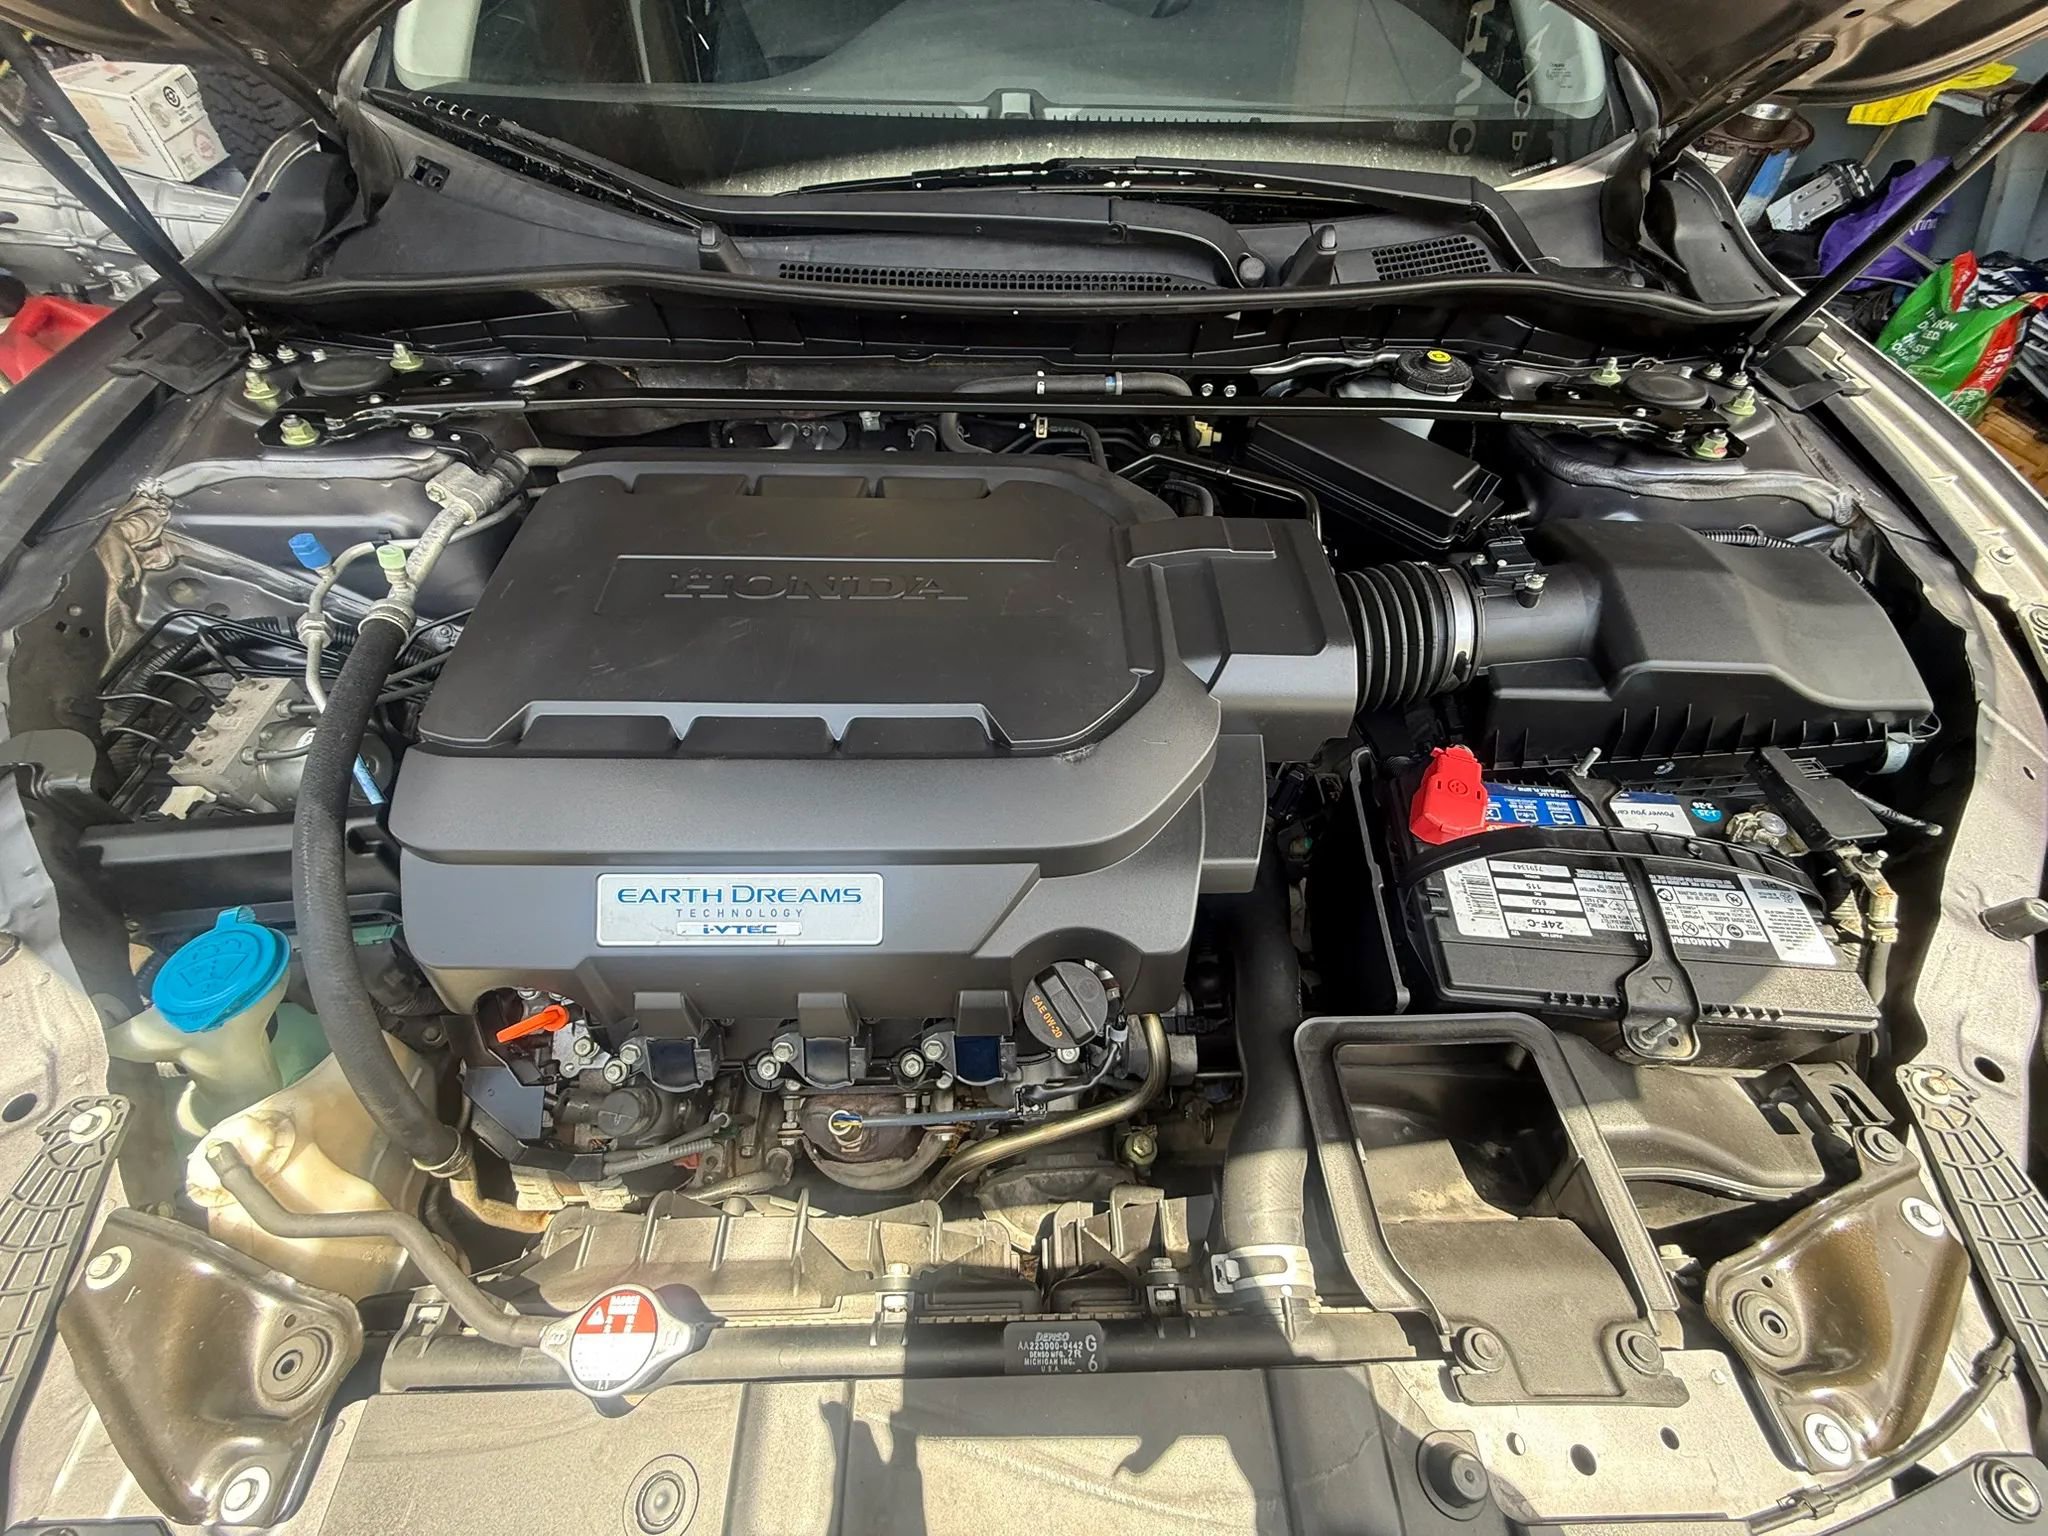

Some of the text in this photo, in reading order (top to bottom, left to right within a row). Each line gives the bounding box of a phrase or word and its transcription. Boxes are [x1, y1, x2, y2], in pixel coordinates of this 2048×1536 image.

[664, 573, 969, 600] HONDA
[617, 884, 863, 905] EARTH DREAMS
[676, 908, 804, 918] TECHNOLOGY
[702, 923, 778, 935] i-VTEC
[1527, 919, 1564, 930] 24F-C
[1031, 995, 1063, 1039] SAE 0W-20
[1035, 1331, 1070, 1342] DENSO
[1085, 1334, 1097, 1352] G
[1024, 1358, 1076, 1366] MICHIGAN INC.
[1088, 1353, 1098, 1372] 6
